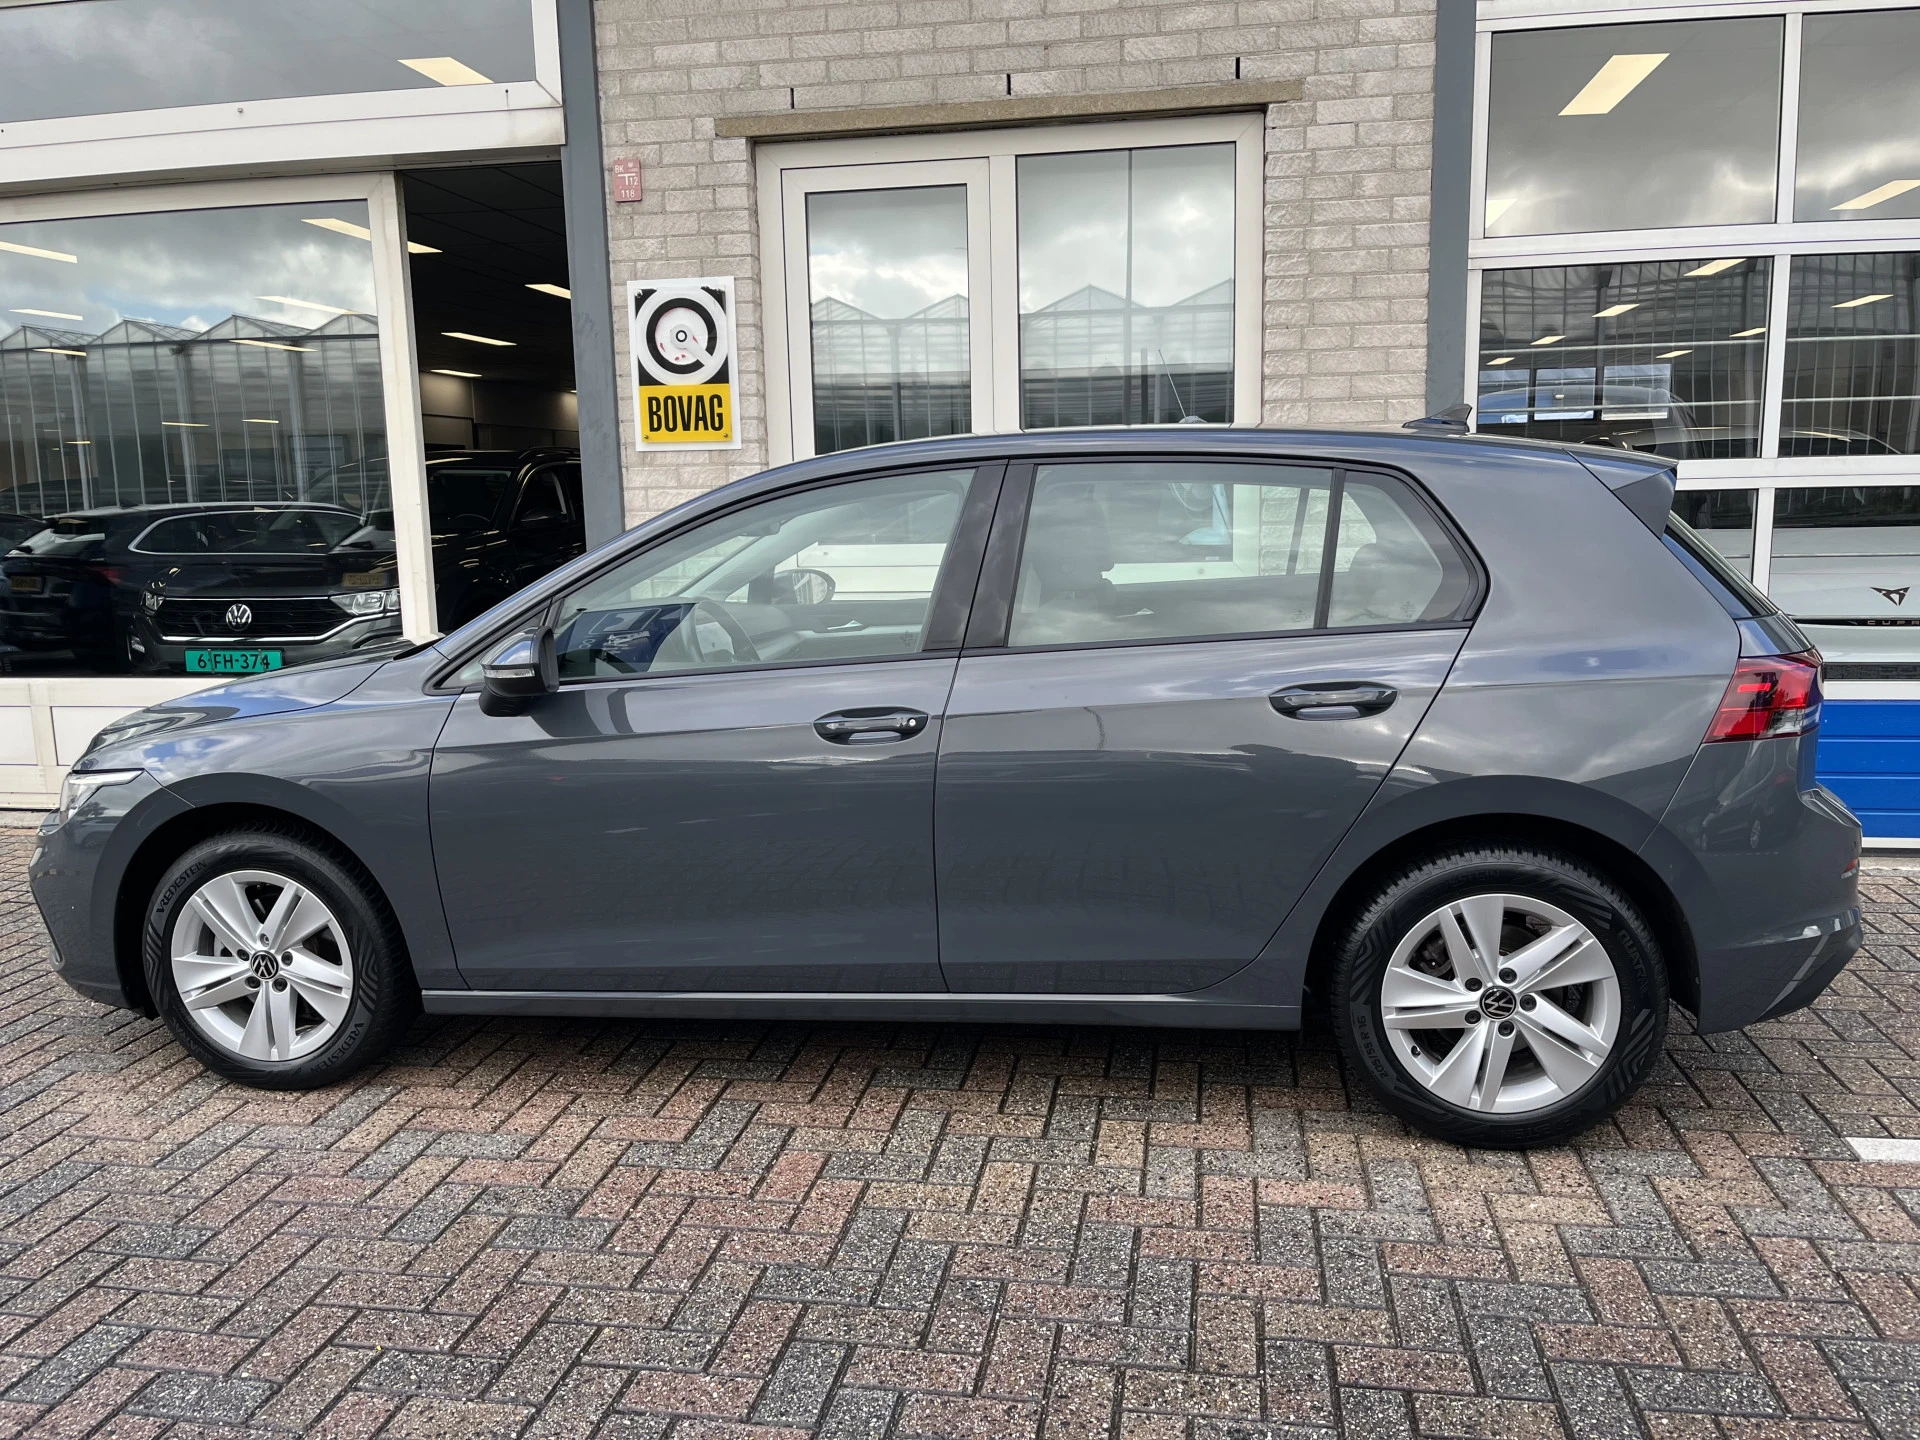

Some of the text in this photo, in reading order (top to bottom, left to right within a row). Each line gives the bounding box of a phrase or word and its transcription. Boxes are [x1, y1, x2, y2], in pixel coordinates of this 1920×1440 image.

[614, 164, 625, 174] BK
[620, 189, 635, 199] 118
[647, 393, 724, 433] BOVAG
[156, 861, 207, 913] VREDESTEIN
[309, 1022, 365, 1074] VREDESTEIN
[1363, 1041, 1389, 1079] 205/55
